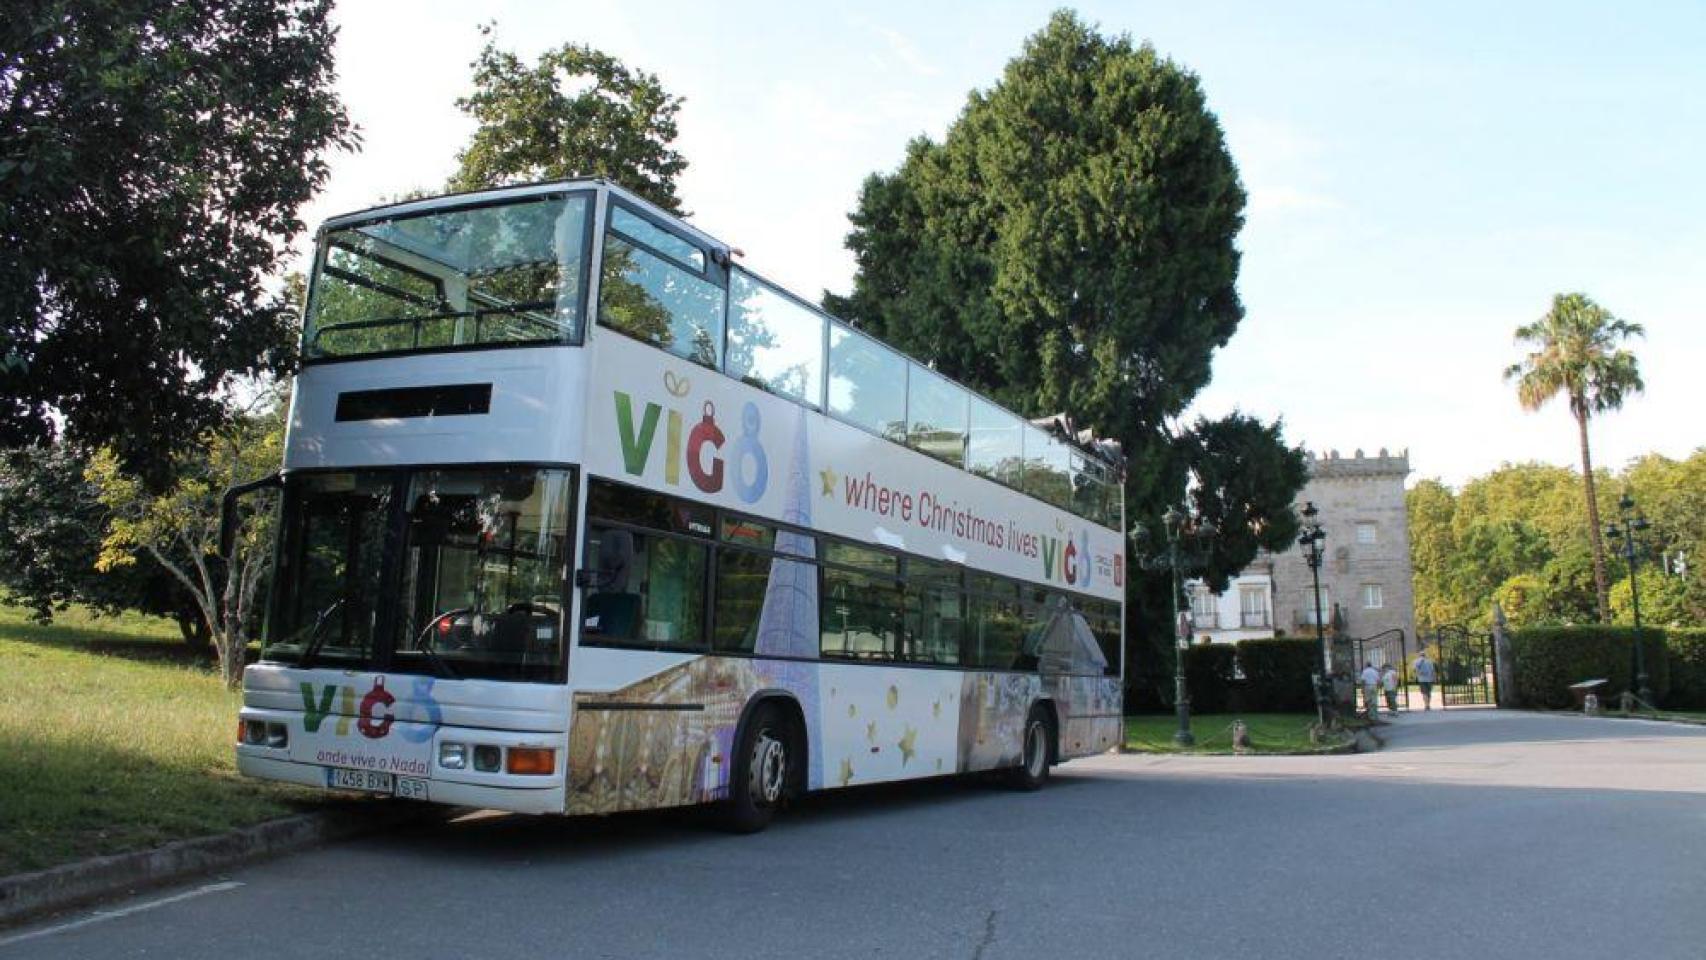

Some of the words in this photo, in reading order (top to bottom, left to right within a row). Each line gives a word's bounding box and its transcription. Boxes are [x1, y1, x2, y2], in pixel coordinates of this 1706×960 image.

[845, 472, 912, 521] where
[918, 491, 1004, 548] Christmas
[1007, 521, 1038, 558] lives
[350, 754, 376, 768] vive
